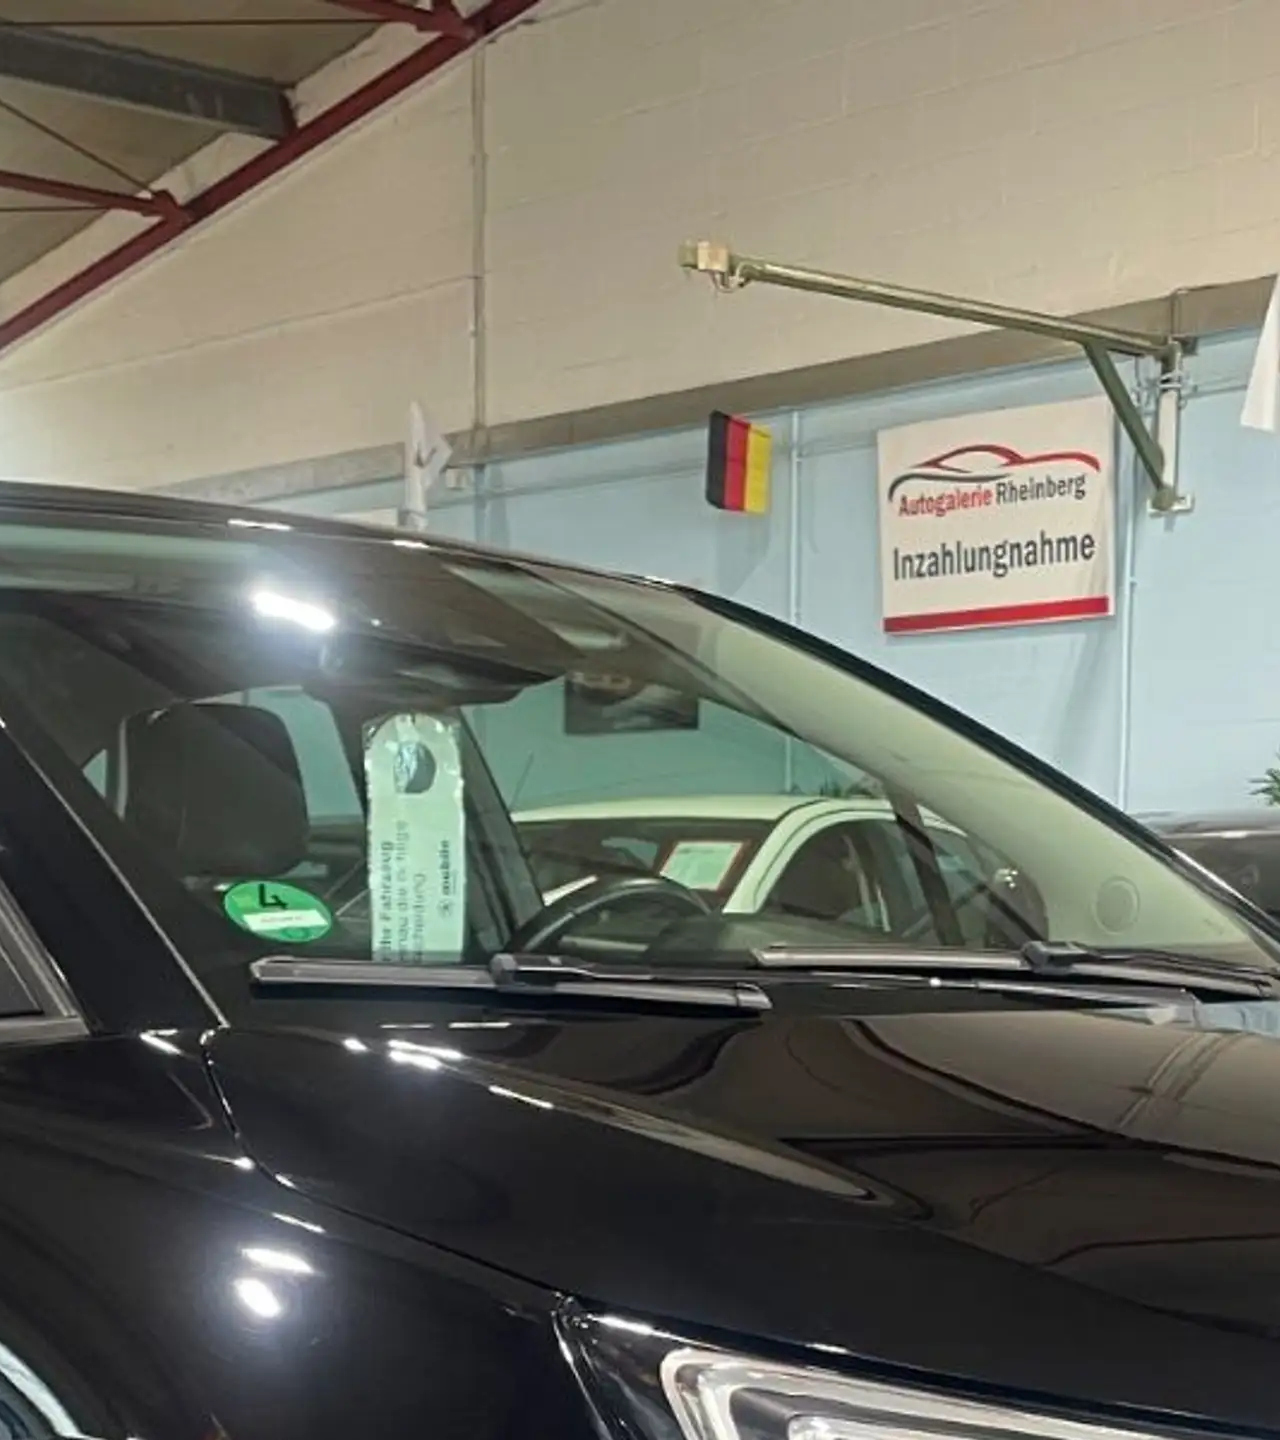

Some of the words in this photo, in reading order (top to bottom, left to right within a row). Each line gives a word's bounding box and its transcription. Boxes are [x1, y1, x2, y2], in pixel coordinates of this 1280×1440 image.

[898, 485, 993, 517] Autogalerie
[995, 474, 1086, 504] Rheinberg
[893, 530, 1095, 581] Inzahlungnahme
[257, 883, 287, 909] 4
